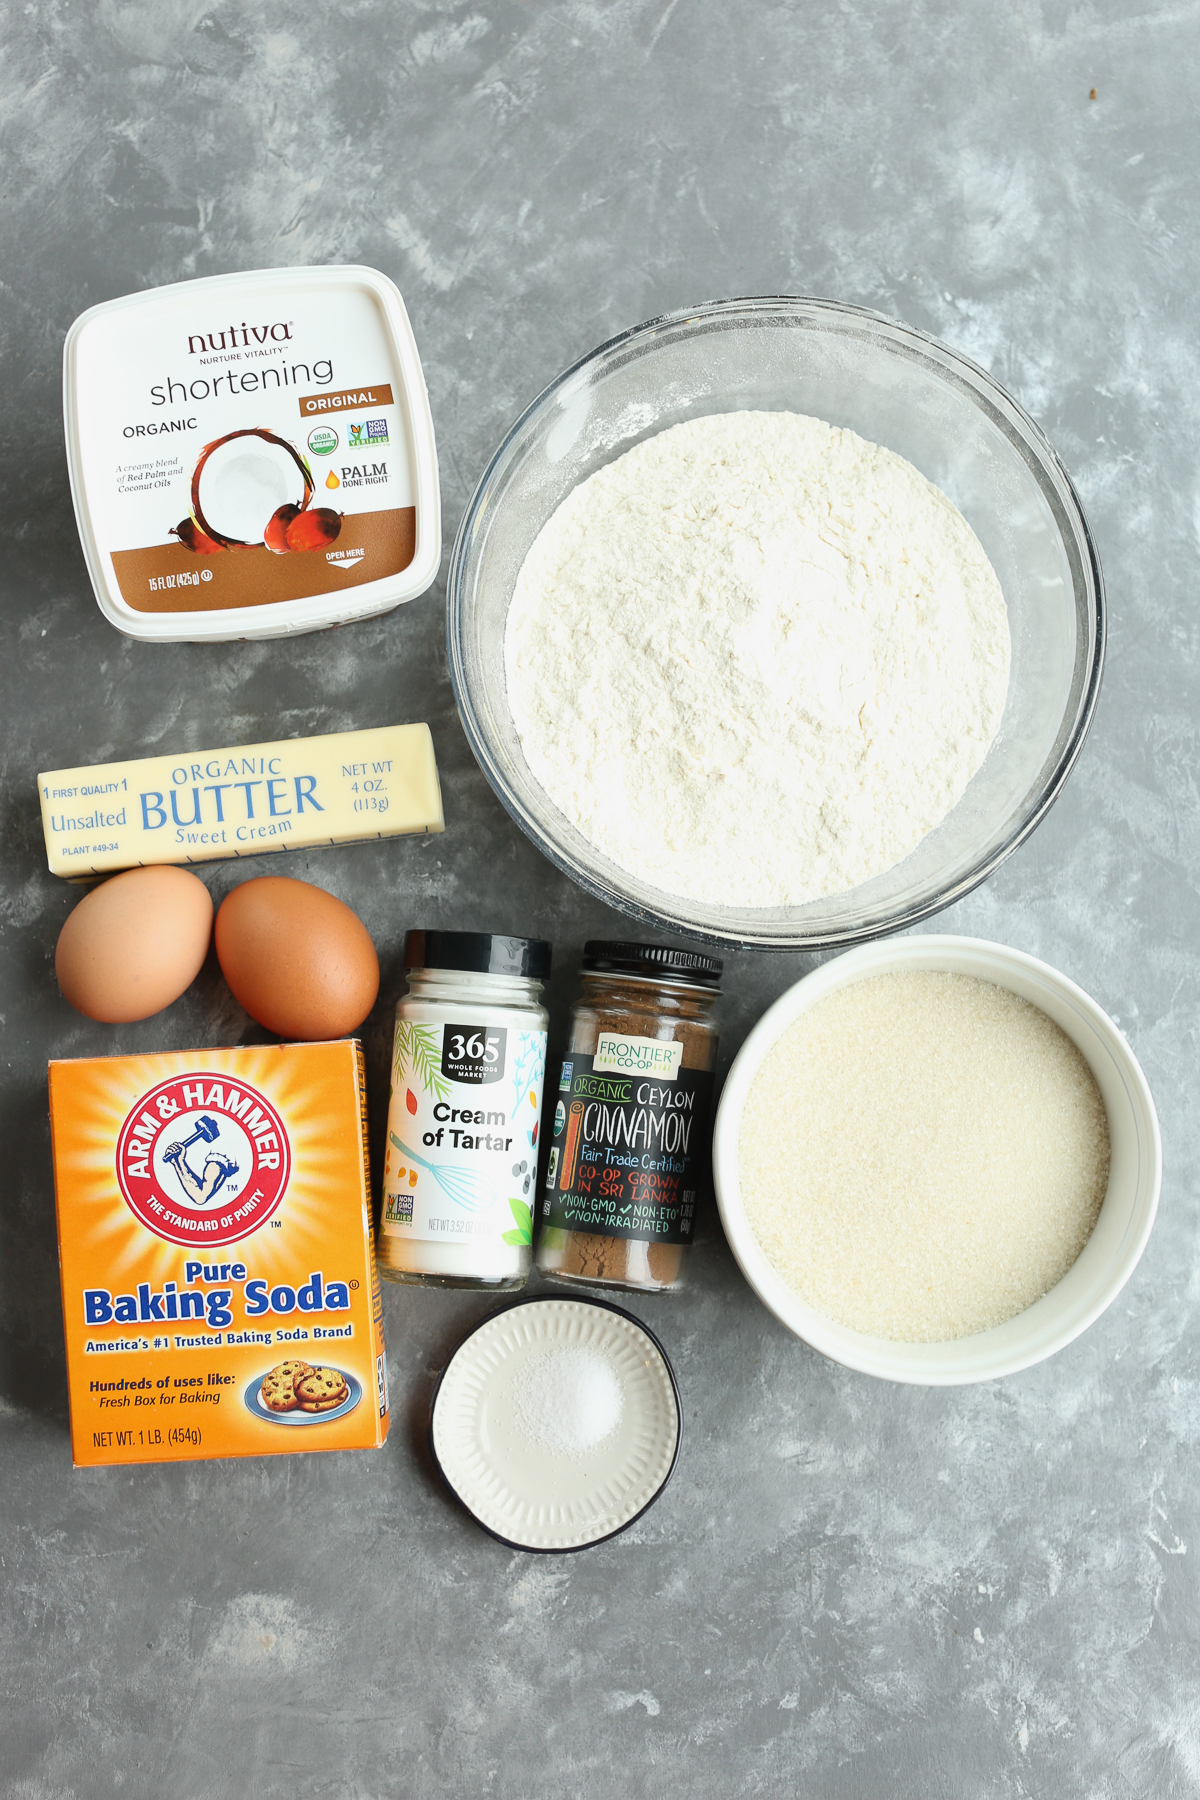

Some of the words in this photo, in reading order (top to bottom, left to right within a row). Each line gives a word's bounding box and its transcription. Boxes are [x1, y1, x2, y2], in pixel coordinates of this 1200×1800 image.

[200, 354, 242, 366] NURTURE
[150, 359, 334, 406] shortening
[306, 391, 377, 412] ORIGINAL
[122, 417, 198, 438] ORGANIC
[368, 420, 386, 428] NON
[312, 440, 335, 449] ORGANIC
[314, 432, 331, 441] USDA
[350, 436, 388, 446] VERIFIED
[115, 465, 122, 473] A
[123, 462, 154, 471] creamy
[156, 457, 178, 467] blend
[116, 474, 126, 484] of
[127, 472, 143, 482] Red
[145, 470, 166, 480] Palm
[167, 466, 183, 476] and
[341, 462, 388, 480] PALM
[118, 482, 152, 493] Coconut
[154, 479, 171, 489] Oils
[342, 478, 364, 488] DONE
[365, 475, 389, 485] RIGHT
[325, 552, 345, 561] OPEN
[346, 547, 365, 558] HERE
[148, 578, 158, 591] 15
[157, 576, 167, 590] FL
[166, 574, 176, 589] OZ
[176, 570, 200, 588] (425g)
[171, 757, 282, 785] ORGANIC
[341, 763, 368, 779] NET
[371, 760, 394, 774] WT
[43, 786, 50, 800] 1
[53, 786, 79, 799] FIRST
[80, 782, 119, 797] QUALITY
[122, 778, 128, 792] 1
[351, 781, 359, 794] 4
[363, 778, 388, 793] OZ.
[139, 774, 325, 831] BUTTER
[353, 796, 390, 814] (113g)
[51, 807, 127, 833] Unsalted
[175, 828, 227, 844] Sweet
[236, 819, 293, 842] Cream
[62, 844, 91, 856] PLANT
[92, 842, 119, 854] #49-34
[448, 1032, 501, 1063] 365
[599, 1041, 672, 1063] FRONTIER
[447, 1063, 473, 1072] WHOLE
[475, 1065, 498, 1073] FOODS
[617, 1057, 652, 1070] CO-OP
[458, 1071, 487, 1079] MARKET
[573, 1076, 632, 1100] ORGANIC
[636, 1083, 695, 1110] CEYLON
[433, 1102, 506, 1126] Cream
[127, 1111, 161, 1179] ARM
[156, 1093, 182, 1119] &
[182, 1082, 281, 1171] HAMMER
[584, 1102, 693, 1155] CINNAMON
[422, 1128, 444, 1147] of
[449, 1128, 513, 1151] Tartar
[581, 1144, 602, 1162] Fair
[604, 1147, 639, 1168] Trade
[641, 1153, 686, 1173] Certified
[578, 1165, 621, 1182] CO-OP
[628, 1172, 680, 1190] GROWN
[398, 1195, 413, 1204] NON
[578, 1179, 591, 1193] IN
[599, 1181, 623, 1198] SRI
[631, 1187, 678, 1204] LANKA
[146, 1194, 163, 1214] THE
[162, 1210, 219, 1232] STANDARD
[220, 1214, 236, 1229] OF
[234, 1187, 266, 1220] PURITY
[398, 1202, 413, 1210] GMO
[567, 1194, 616, 1213] NON-GMO
[386, 1212, 412, 1222] VERIFIED
[428, 1218, 440, 1231] NET
[440, 1219, 450, 1231] WT
[450, 1220, 464, 1233] 3.52
[465, 1221, 474, 1233] OZ
[575, 1212, 668, 1232] NON-IRRADIATED
[186, 1261, 247, 1284] Pure
[83, 1281, 232, 1329] Baking
[244, 1271, 351, 1315] Soda
[86, 1338, 149, 1352] America's
[153, 1337, 169, 1349] #1
[174, 1333, 223, 1348] Trusted
[227, 1330, 272, 1346] Baking
[276, 1328, 309, 1340] Soda
[313, 1325, 352, 1338] Brand
[89, 1377, 153, 1393] Hundreds
[156, 1376, 171, 1390] of
[173, 1376, 203, 1389] uses
[207, 1373, 236, 1387] like:
[99, 1394, 131, 1408] Fresh
[134, 1394, 156, 1407] Box
[158, 1393, 174, 1406] for
[179, 1391, 221, 1406] Baking
[93, 1431, 114, 1448] NET
[116, 1430, 136, 1446] WT.
[138, 1431, 143, 1445] 1
[147, 1429, 165, 1445] LB.
[167, 1427, 202, 1446] (454g)
